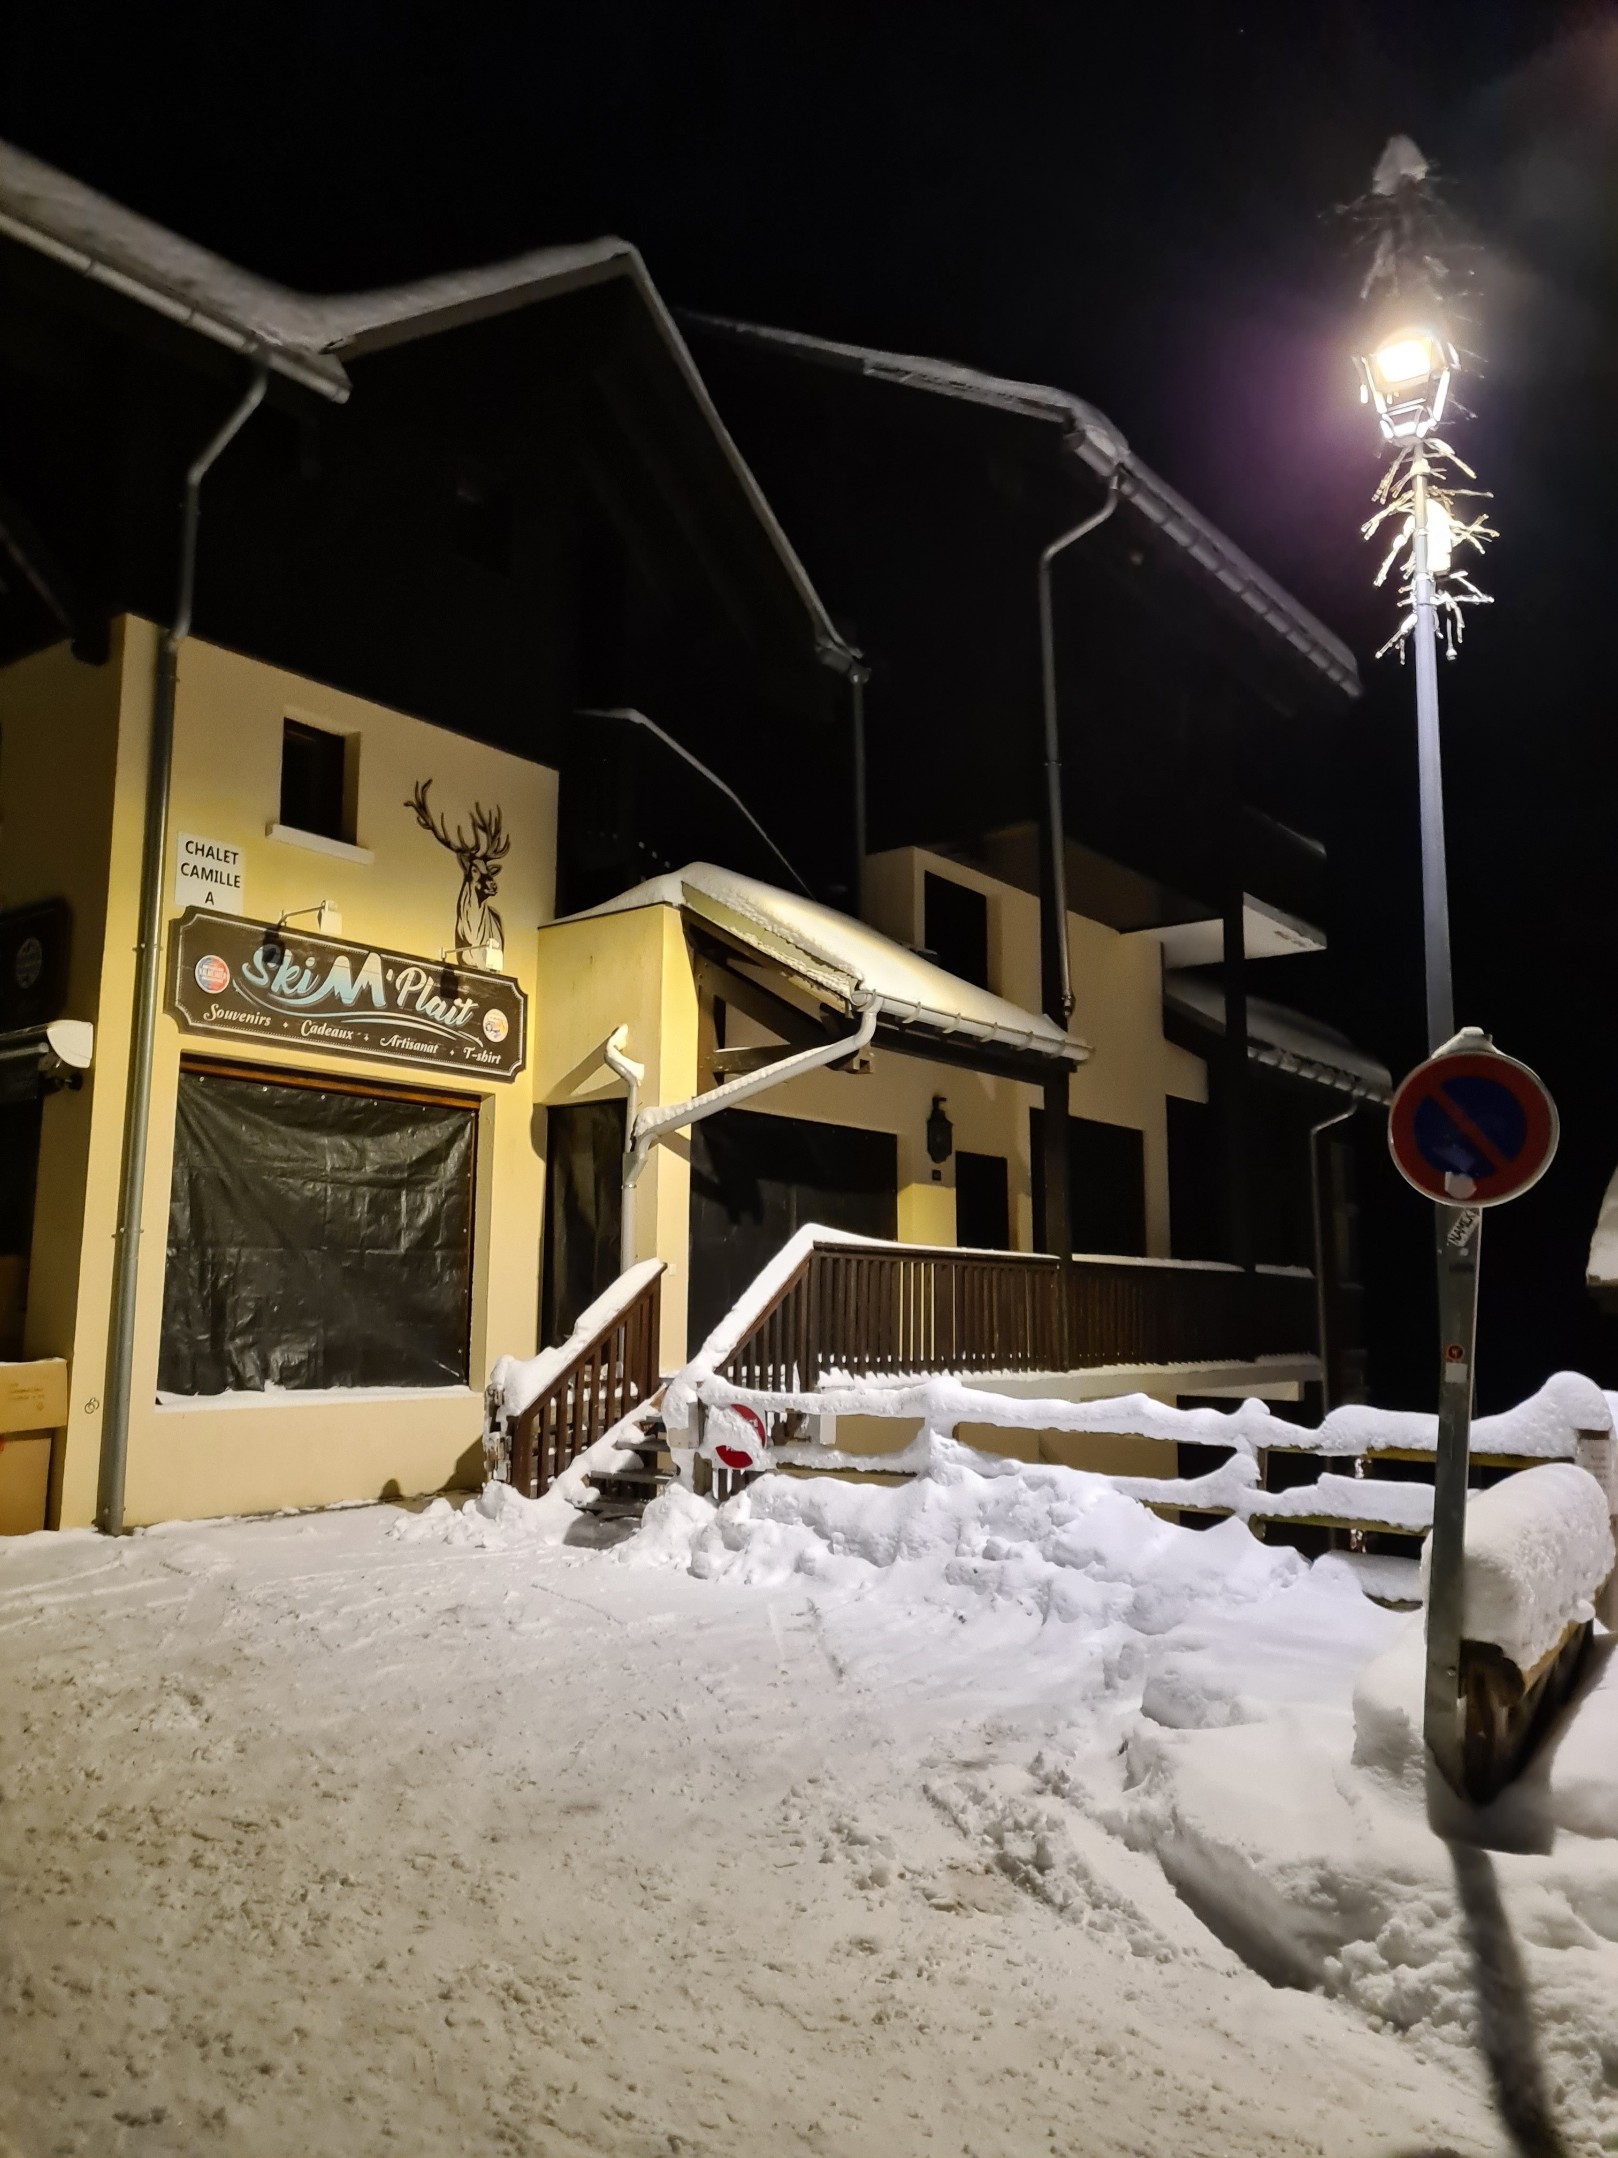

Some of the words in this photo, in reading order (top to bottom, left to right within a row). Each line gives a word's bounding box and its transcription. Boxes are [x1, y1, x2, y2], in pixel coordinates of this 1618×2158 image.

[185, 840, 239, 866] CHALET
[180, 862, 241, 889] CAMILLE
[204, 891, 215, 906] A
[203, 1003, 272, 1027] Souvenirs
[300, 1019, 354, 1041] Cadeaux
[379, 1034, 440, 1054] Artisanat
[463, 1046, 502, 1065] T-shirt
